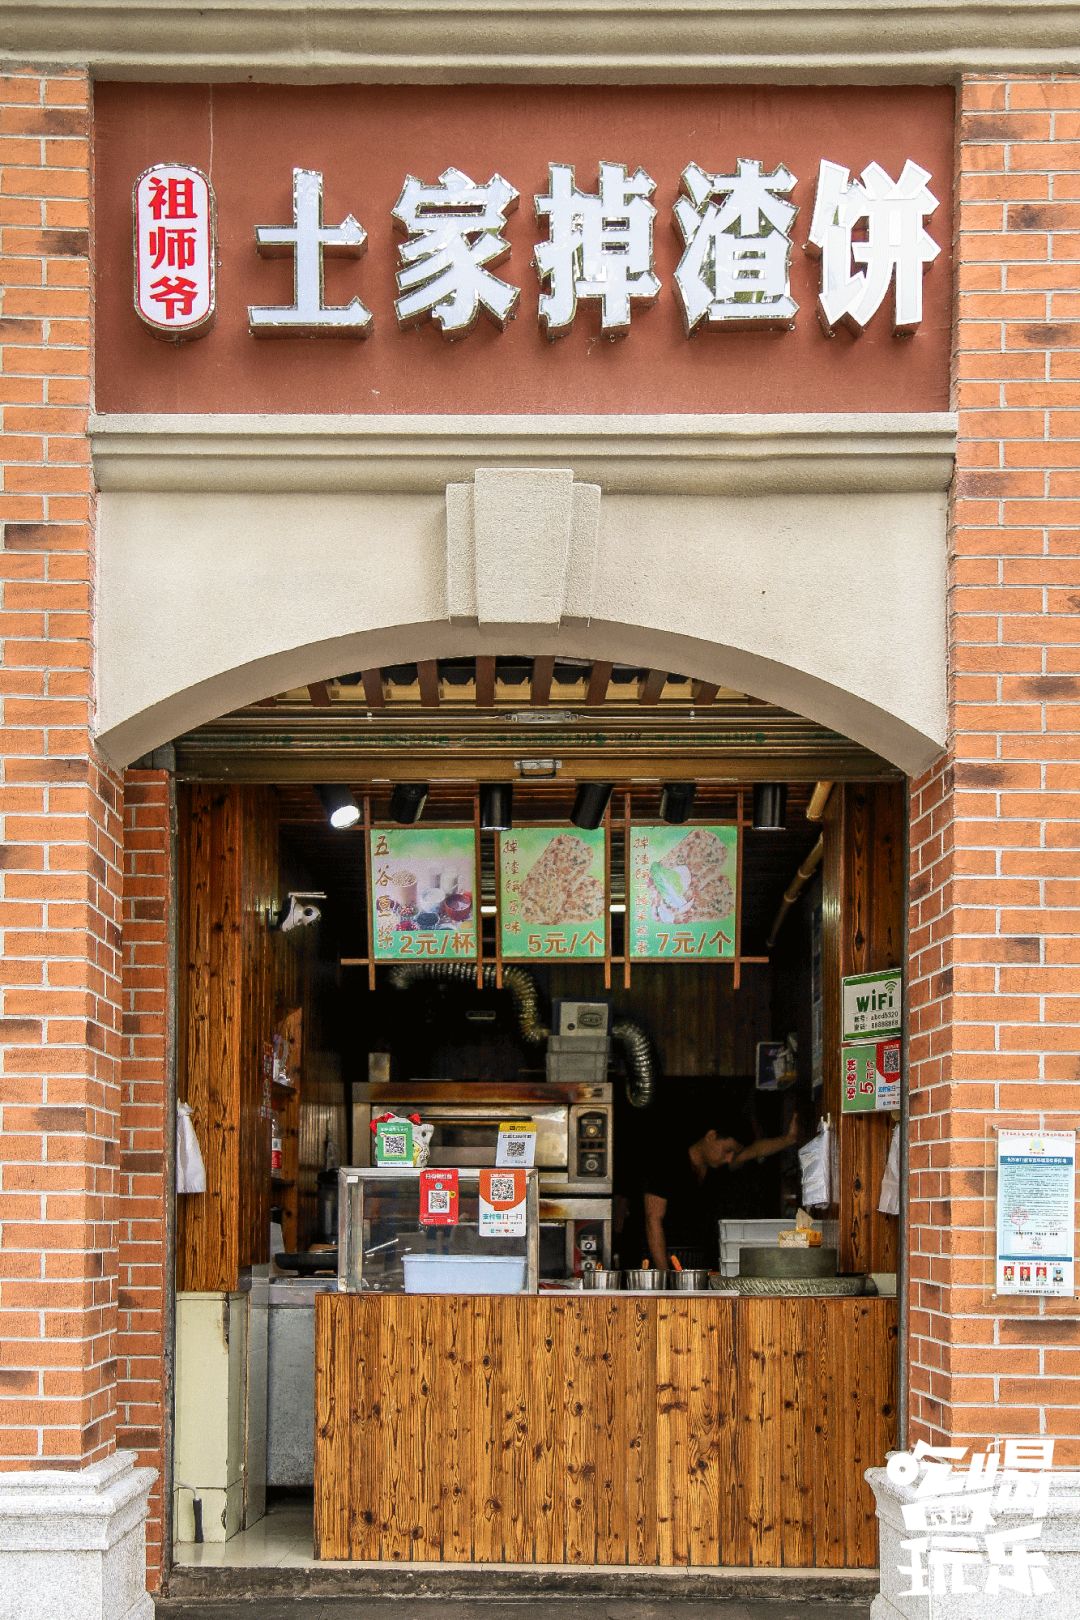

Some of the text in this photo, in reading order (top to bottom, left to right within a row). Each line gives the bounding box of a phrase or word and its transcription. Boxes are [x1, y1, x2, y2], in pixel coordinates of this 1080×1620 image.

[148, 176, 199, 321] 祖师爷
[247, 157, 942, 338] 土家掉渣饼
[400, 933, 475, 955] 2元/杯
[528, 930, 603, 954] 5元/个
[656, 930, 732, 954] 7元/个
